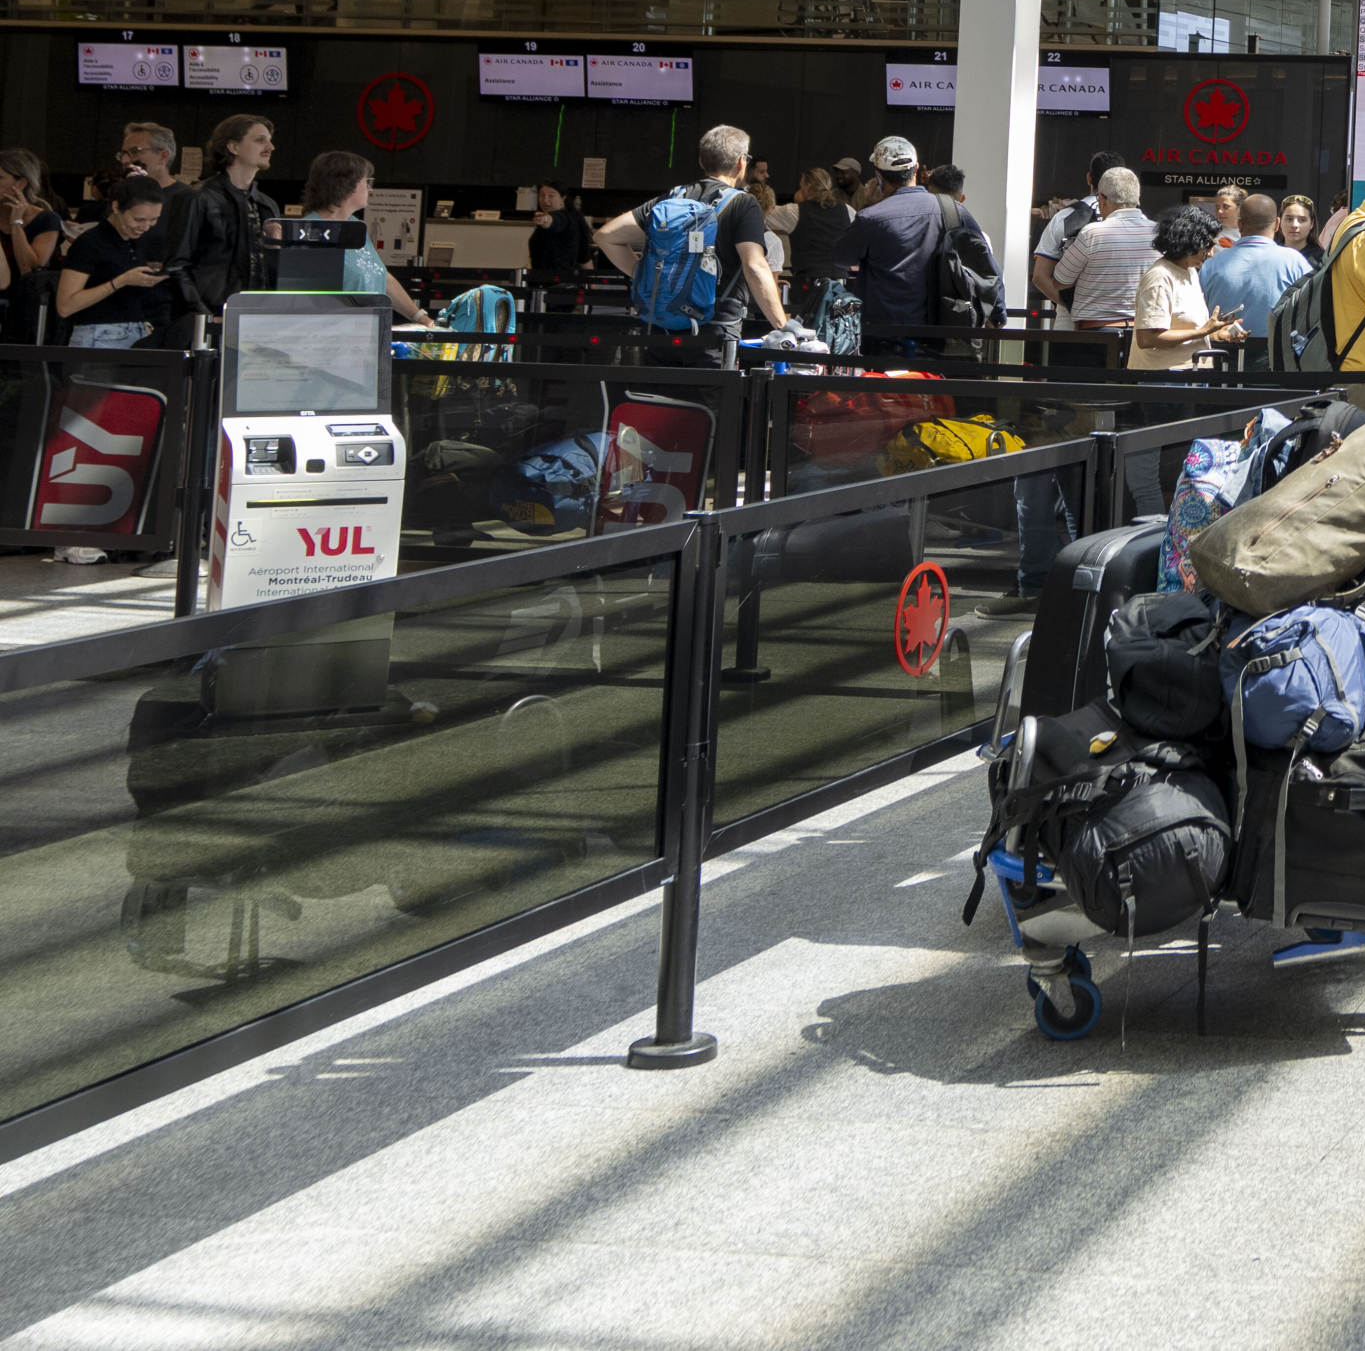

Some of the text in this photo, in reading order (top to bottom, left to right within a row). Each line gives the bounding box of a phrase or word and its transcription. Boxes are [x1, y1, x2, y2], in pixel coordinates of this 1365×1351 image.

[122, 31, 133, 40] 17
[229, 33, 241, 43] 18
[525, 41, 537, 51] 19
[632, 42, 646, 53] 20
[934, 51, 947, 61] 21
[1047, 53, 1061, 62] 22
[909, 80, 934, 89] AIR
[1050, 84, 1106, 94] CANADA
[1142, 146, 1290, 168] AIR CANADA
[1164, 174, 1253, 186] STAR ALLIANCE
[296, 526, 375, 557] YUL
[247, 563, 375, 578] Aéroport International
[268, 574, 373, 586] Montréal-Trudeau
